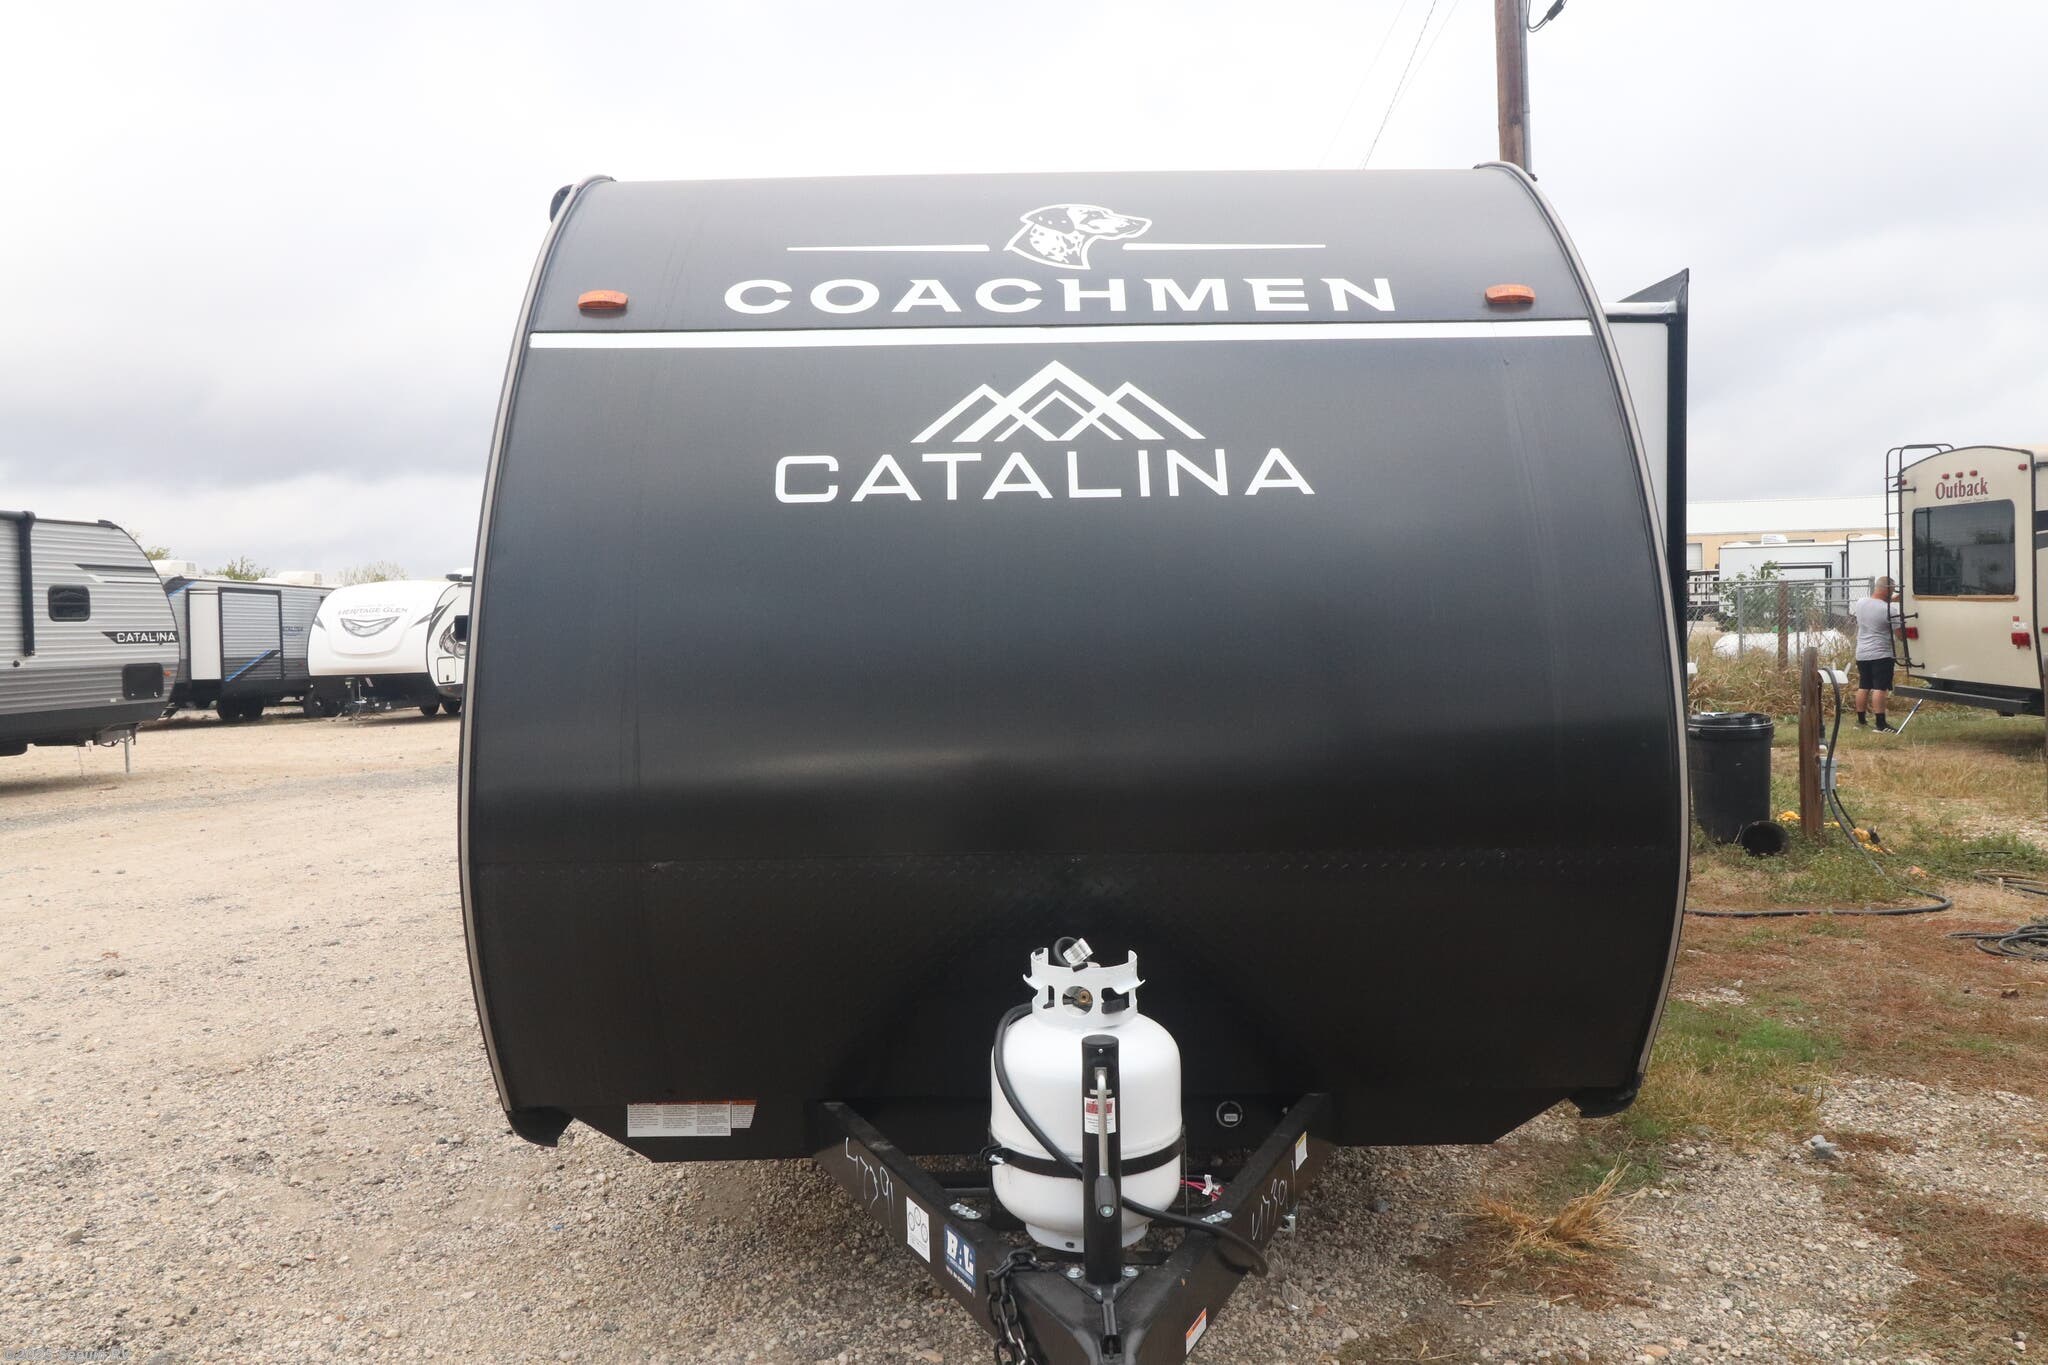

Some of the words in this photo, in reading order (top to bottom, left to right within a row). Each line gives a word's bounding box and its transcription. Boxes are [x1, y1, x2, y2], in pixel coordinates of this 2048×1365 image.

[724, 277, 1396, 315] COACHMEN
[774, 446, 1316, 504] CATALINA
[1935, 477, 1988, 500] Outback
[338, 607, 381, 616] HERITAGE
[382, 606, 408, 614] GLEN
[116, 631, 176, 643] CATALINA
